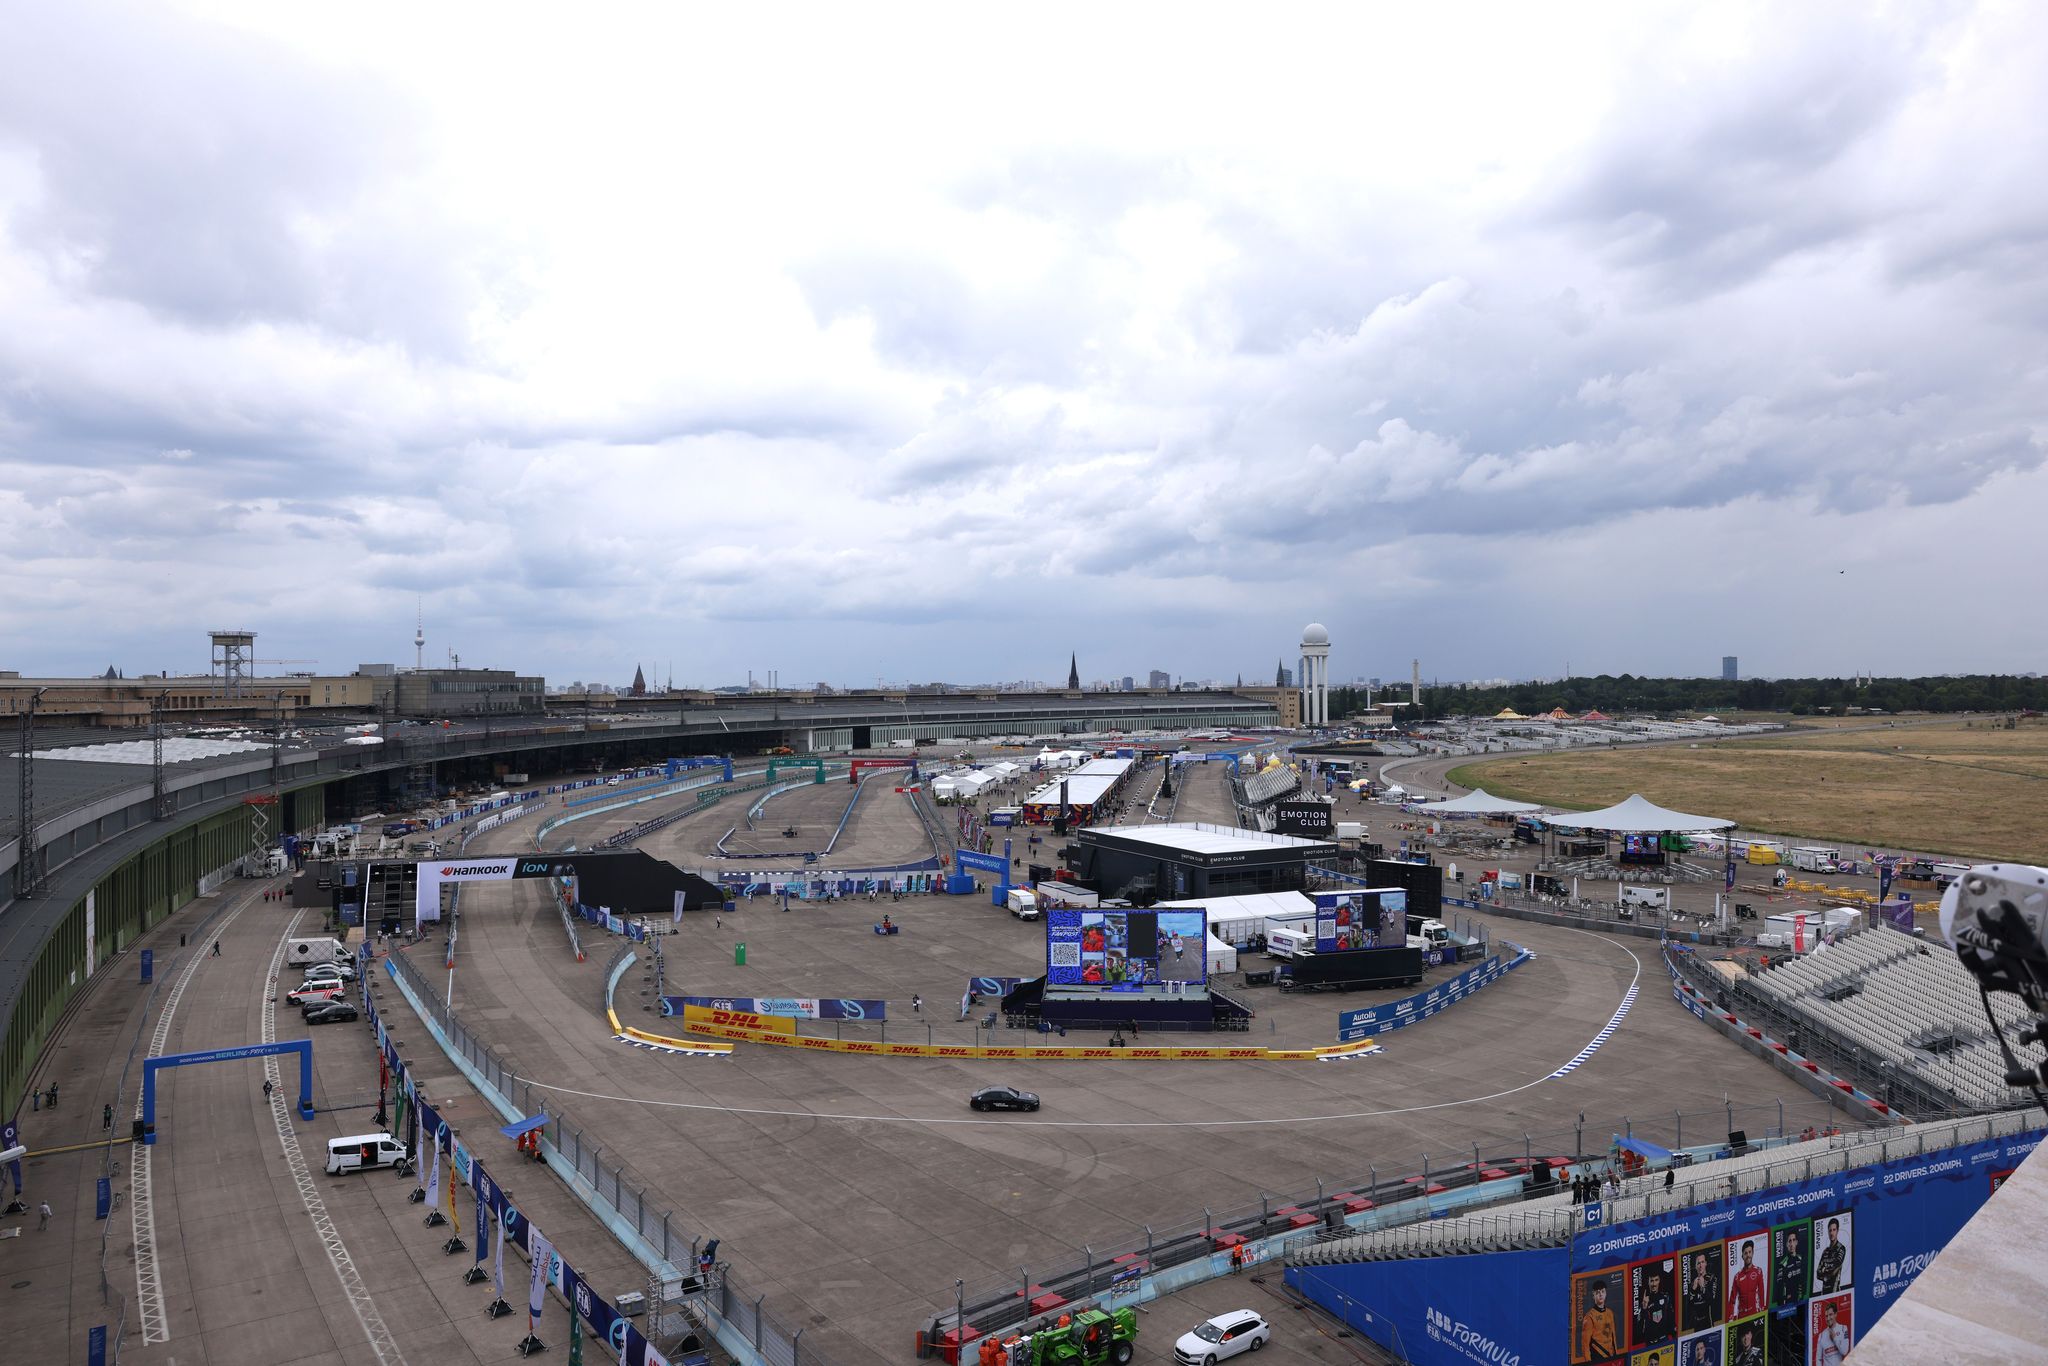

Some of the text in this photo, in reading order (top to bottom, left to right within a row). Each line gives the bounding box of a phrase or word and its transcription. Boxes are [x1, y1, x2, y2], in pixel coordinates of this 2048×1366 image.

[1281, 810, 1327, 820] EMOTION
[1300, 818, 1327, 827] CLUB
[1430, 954, 1442, 963] FIA
[1469, 968, 1480, 979] Autoliv
[1450, 979, 1460, 990] Autoliv
[1427, 990, 1440, 1001] Autoliv
[1396, 1001, 1413, 1013] Autoliv
[712, 1011, 764, 1030] DHL
[1352, 1010, 1377, 1022] Autoliv
[1405, 1014, 1416, 1023] Autoliv
[691, 1024, 712, 1033] DHL
[1380, 1022, 1393, 1030] Autoliv
[725, 1030, 748, 1039] DHL
[1349, 1028, 1365, 1037] Autoliv
[764, 1035, 789, 1044] DHL
[804, 1040, 830, 1048] DHL
[847, 1044, 874, 1052] DHL
[892, 1046, 921, 1054] DHL
[939, 1048, 968, 1056] DHL
[2007, 1146, 2017, 1156] 22
[1884, 1158, 1964, 1185] 22 DRIVERS. 200MPH.
[1746, 1188, 1836, 1217] 22 DRIVERS. 200MPH.
[1587, 1209, 1601, 1221] C1
[1588, 1222, 1691, 1255] 22 DRIVERS. 200MPH.
[1873, 1262, 1898, 1282] ABB
[1873, 1280, 1909, 1297] FIA WORLD
[1426, 1306, 1452, 1333] ABB
[1427, 1324, 1440, 1341] FIA
[1442, 1336, 1464, 1353] WORLD
